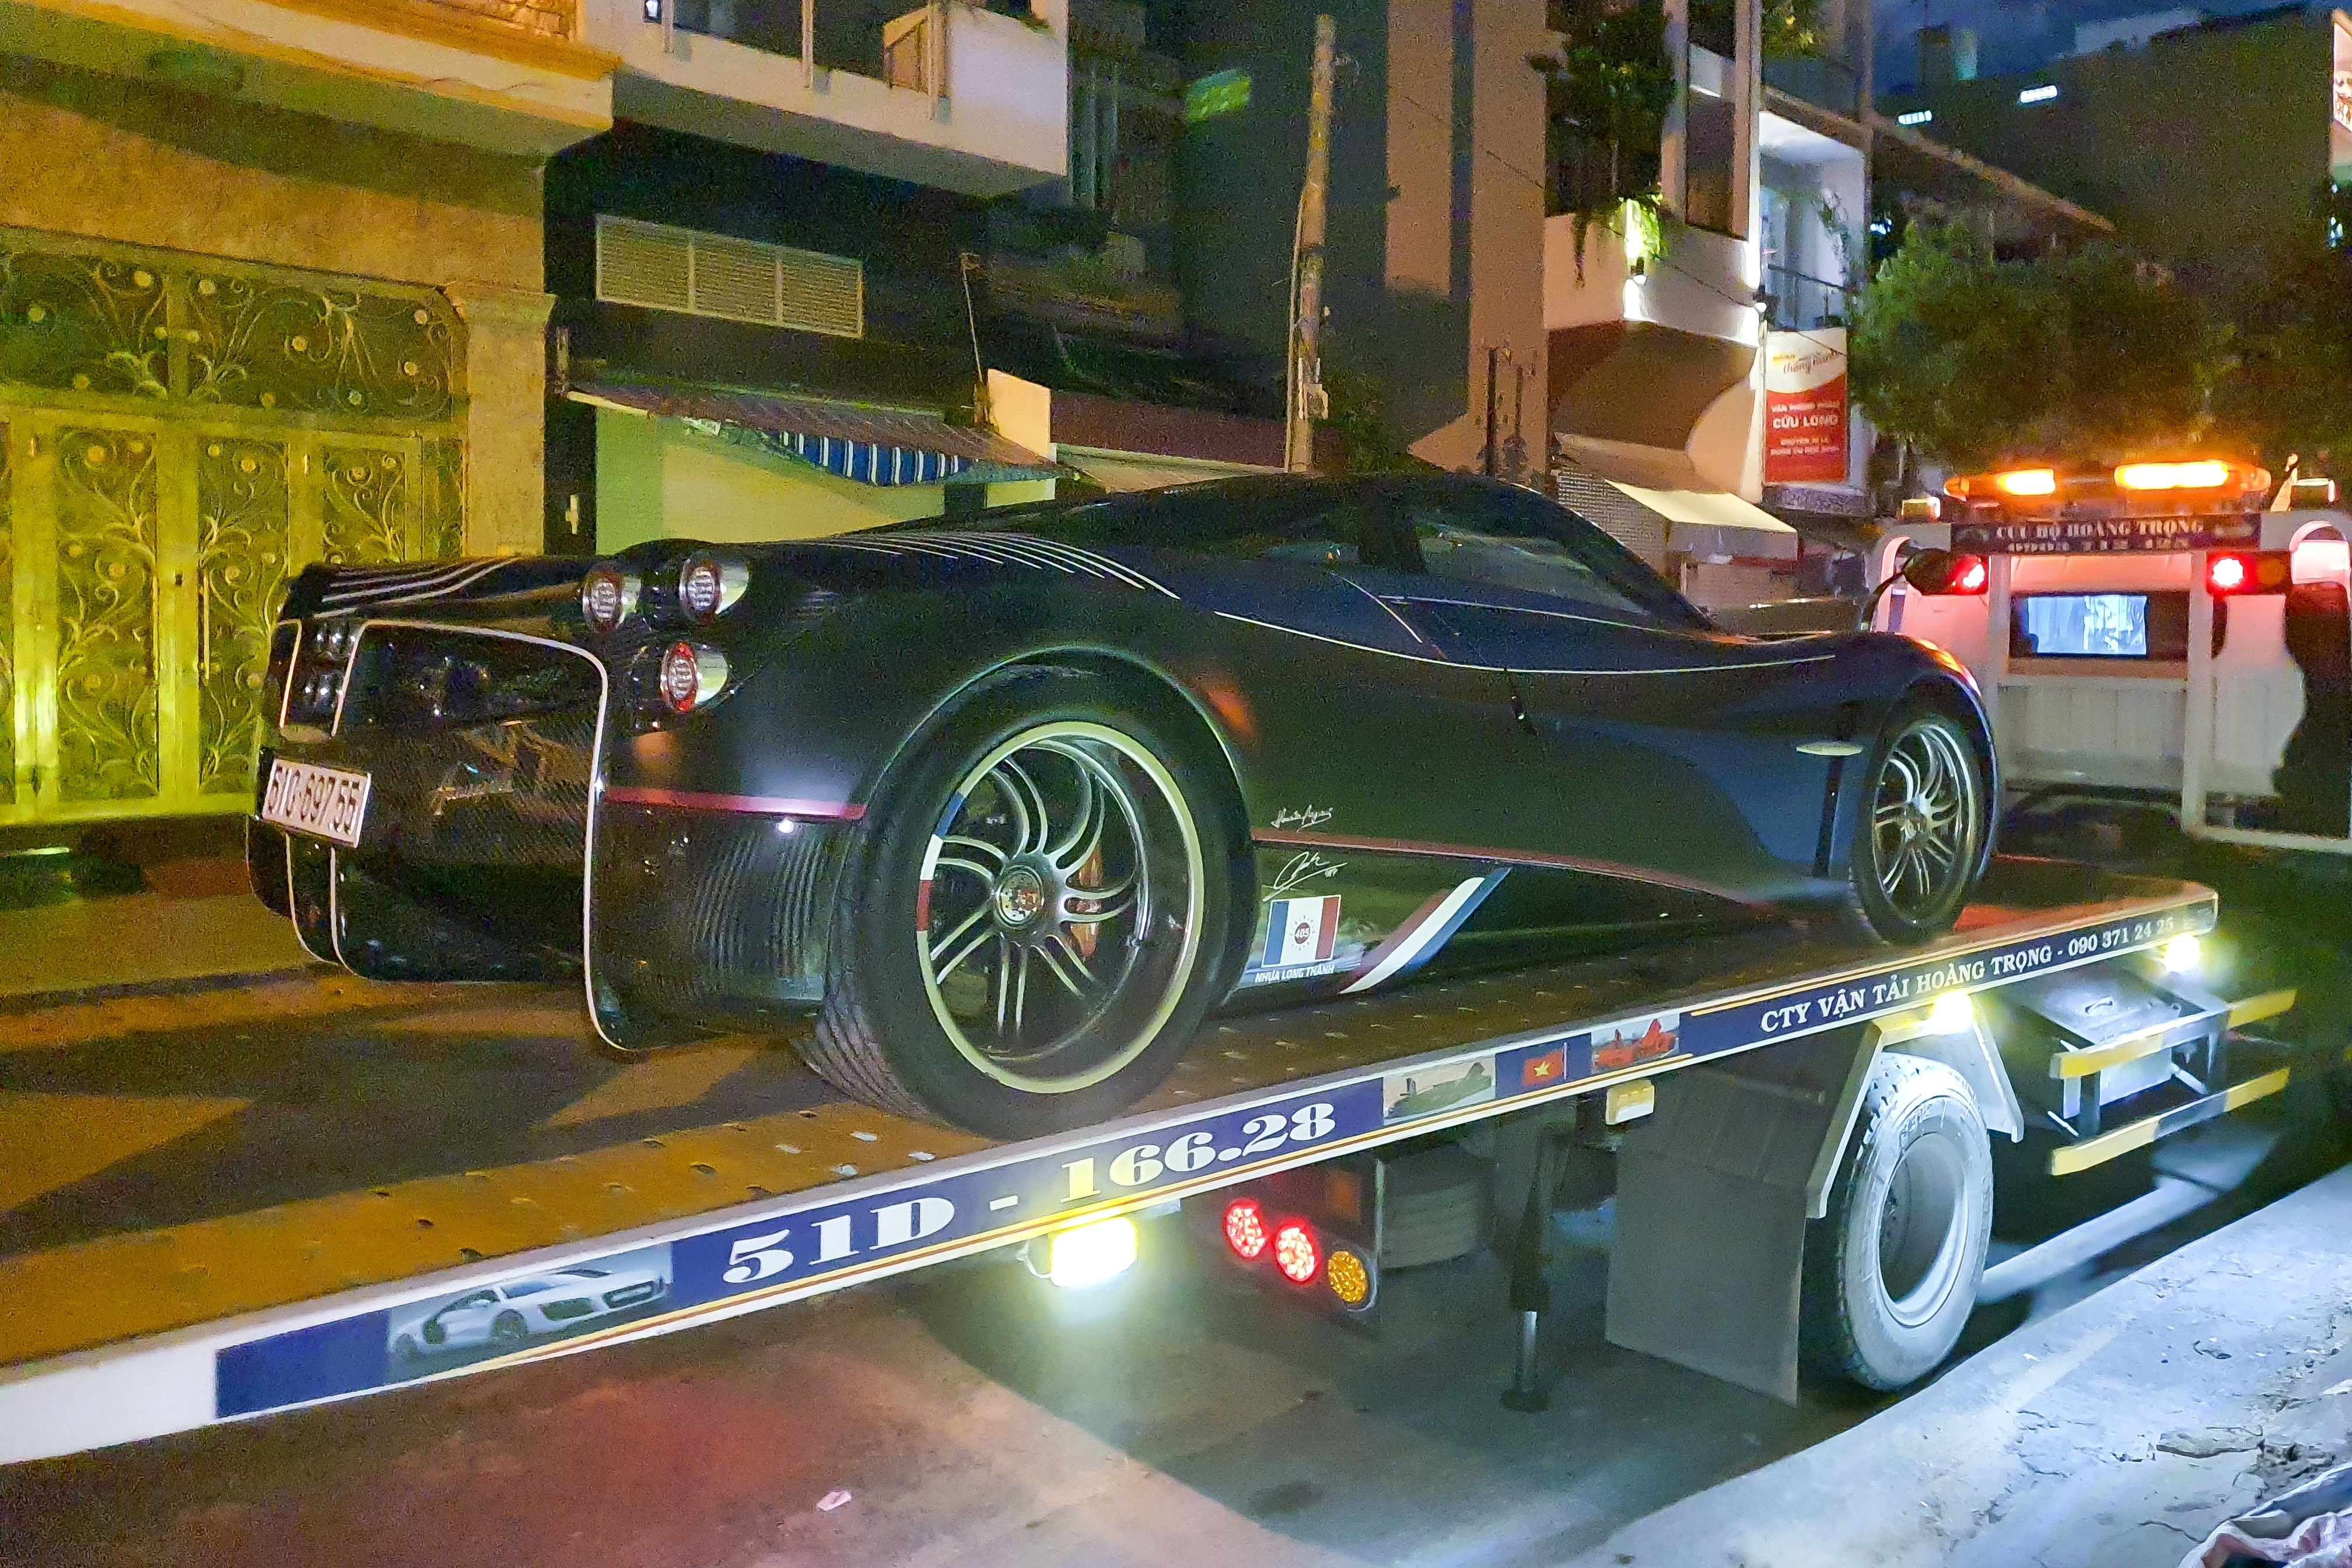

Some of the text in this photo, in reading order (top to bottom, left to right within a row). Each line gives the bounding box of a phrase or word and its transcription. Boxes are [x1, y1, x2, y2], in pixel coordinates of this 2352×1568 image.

[1803, 415, 1839, 427] LONG
[1281, 967, 1306, 981] LONG
[1760, 1002, 1811, 1032] CTY
[1818, 988, 1866, 1019] VẬN
[1872, 974, 1910, 1006] TẢI
[1916, 960, 1985, 994] HOÀNG
[1990, 945, 2052, 975] TRỌNG
[2068, 933, 2098, 957] 090
[2102, 927, 2129, 949] 371
[2134, 922, 2152, 941] 24
[723, 1102, 1336, 1284] 51D - 166.28
